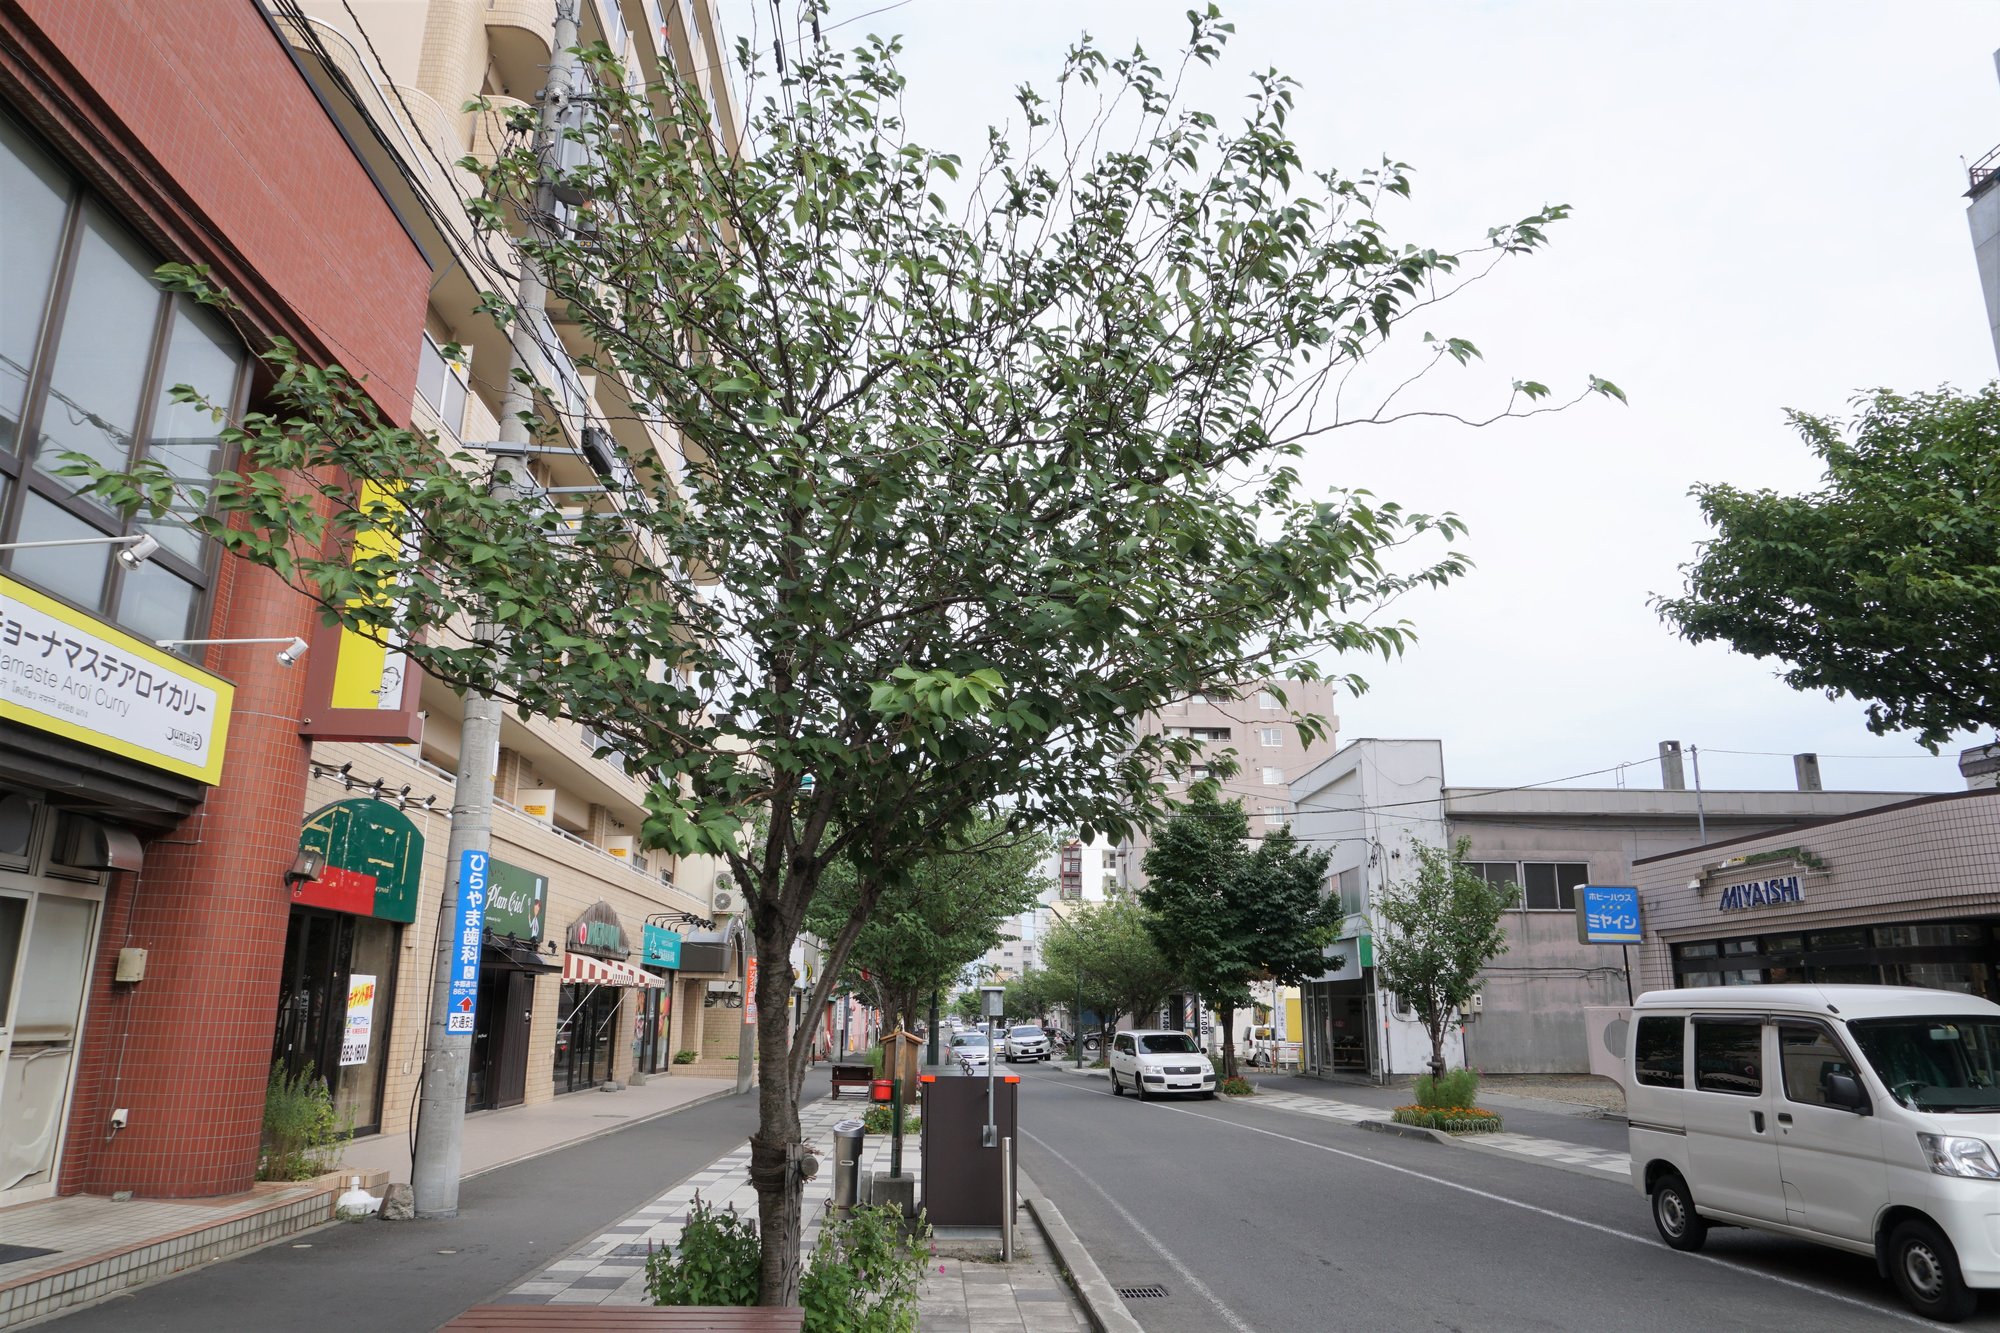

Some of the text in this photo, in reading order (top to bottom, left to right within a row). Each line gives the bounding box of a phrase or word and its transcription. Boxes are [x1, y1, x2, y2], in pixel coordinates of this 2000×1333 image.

[0, 610, 206, 716] ョーナマステアロイカリー
[0, 648, 130, 718] amaste Aroi Curry
[461, 854, 486, 965] ひらやま歯科
[485, 883, 508, 911] Plan
[1719, 876, 1801, 911] MIYAISHI
[1588, 913, 1637, 930] ミヤイシ
